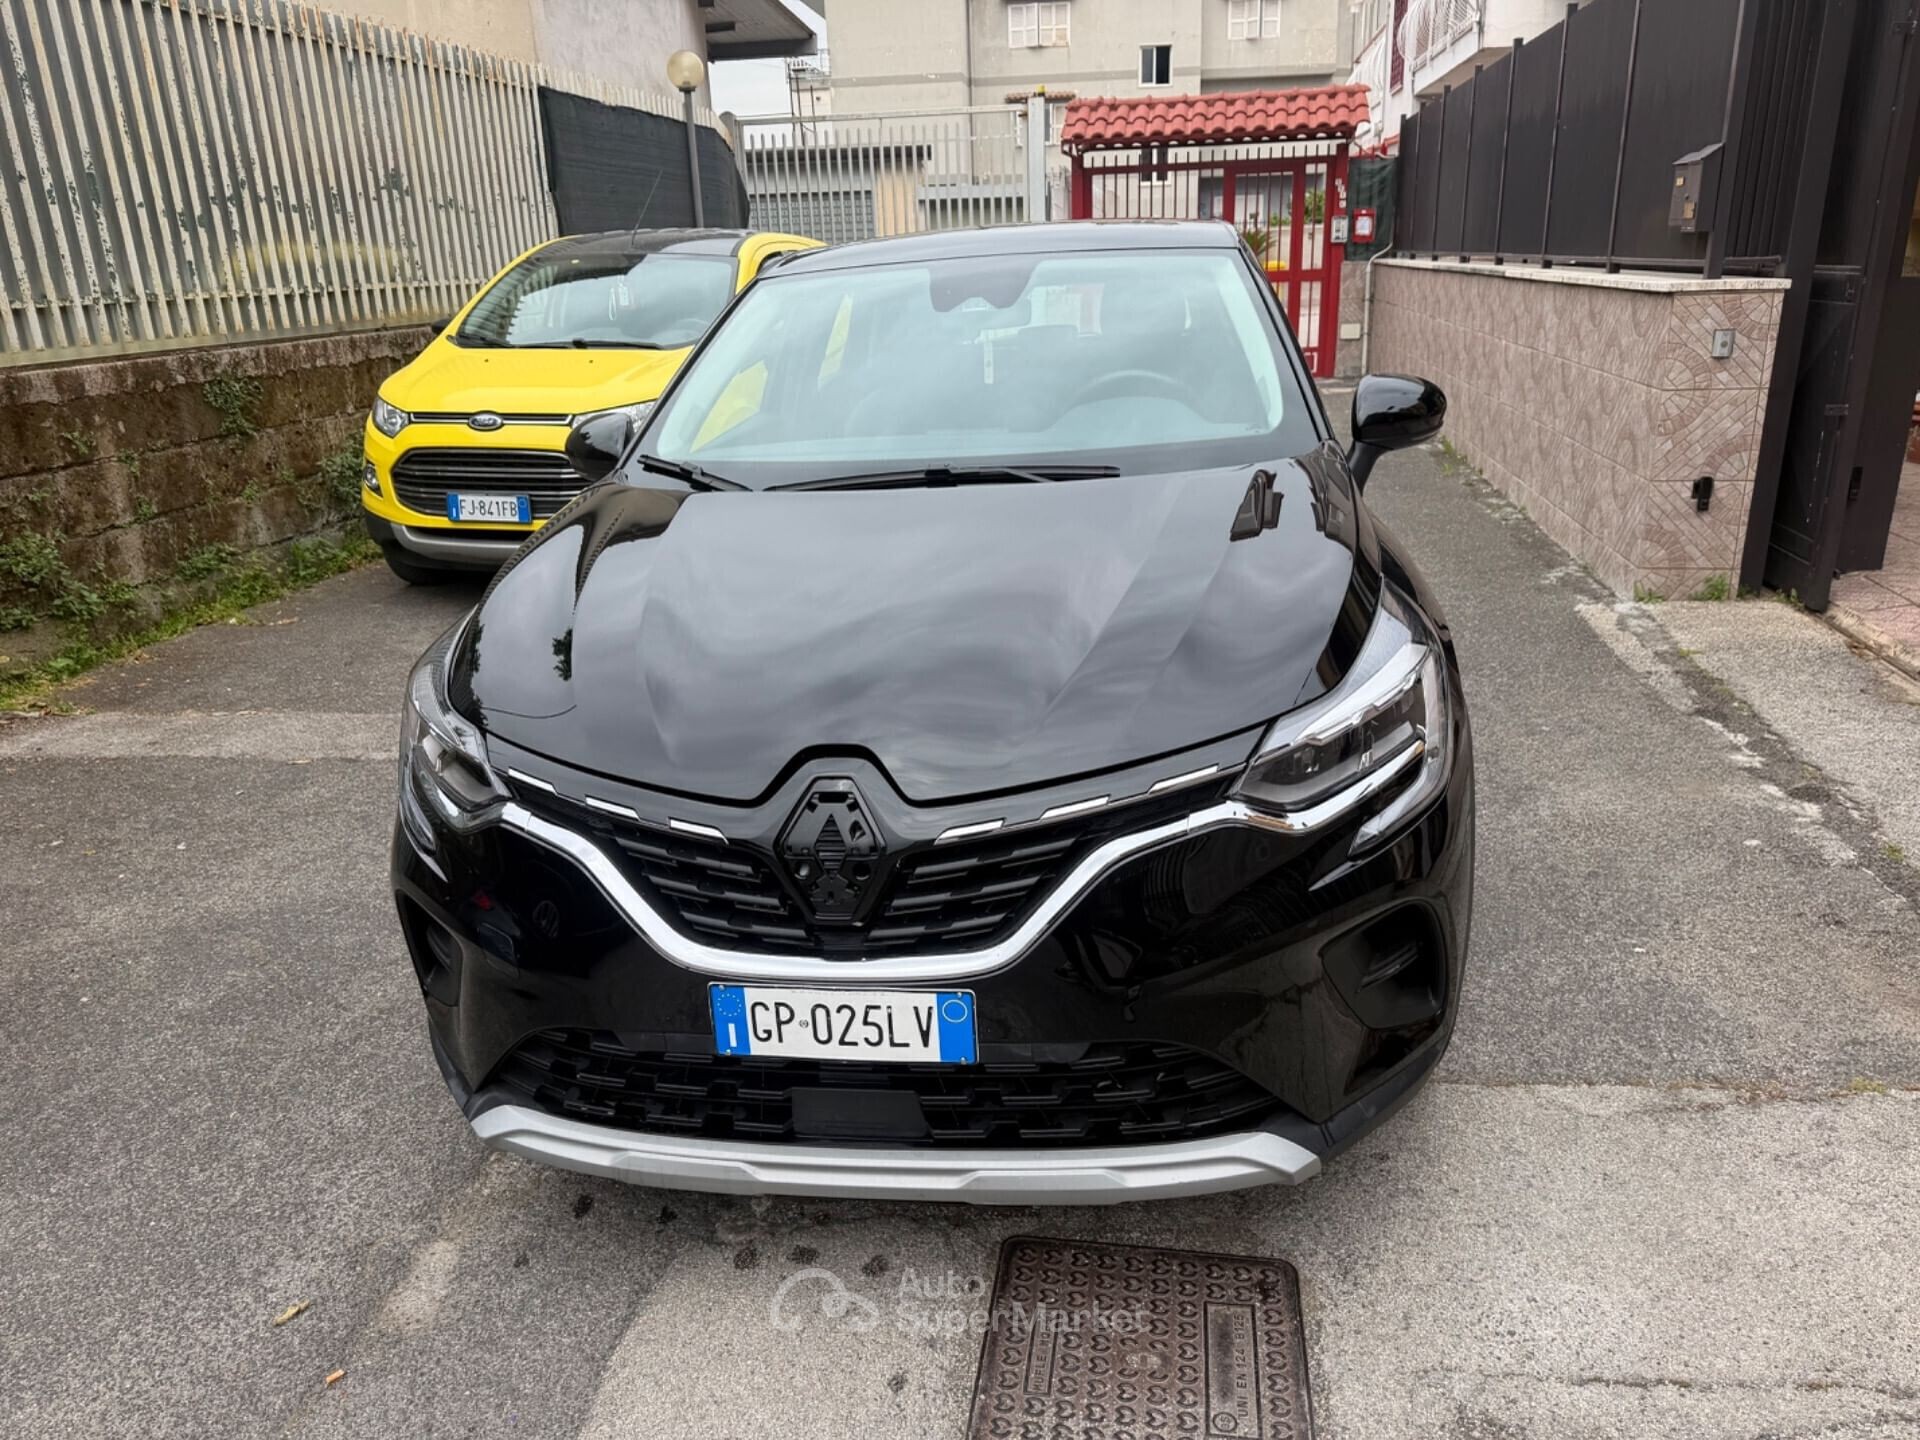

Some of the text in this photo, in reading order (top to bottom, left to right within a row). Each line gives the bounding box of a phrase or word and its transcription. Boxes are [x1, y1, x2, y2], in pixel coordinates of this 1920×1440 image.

[1235, 1348, 1246, 1369] 124
[1236, 1373, 1247, 1390] EN
[1237, 1395, 1249, 1418] UNI
